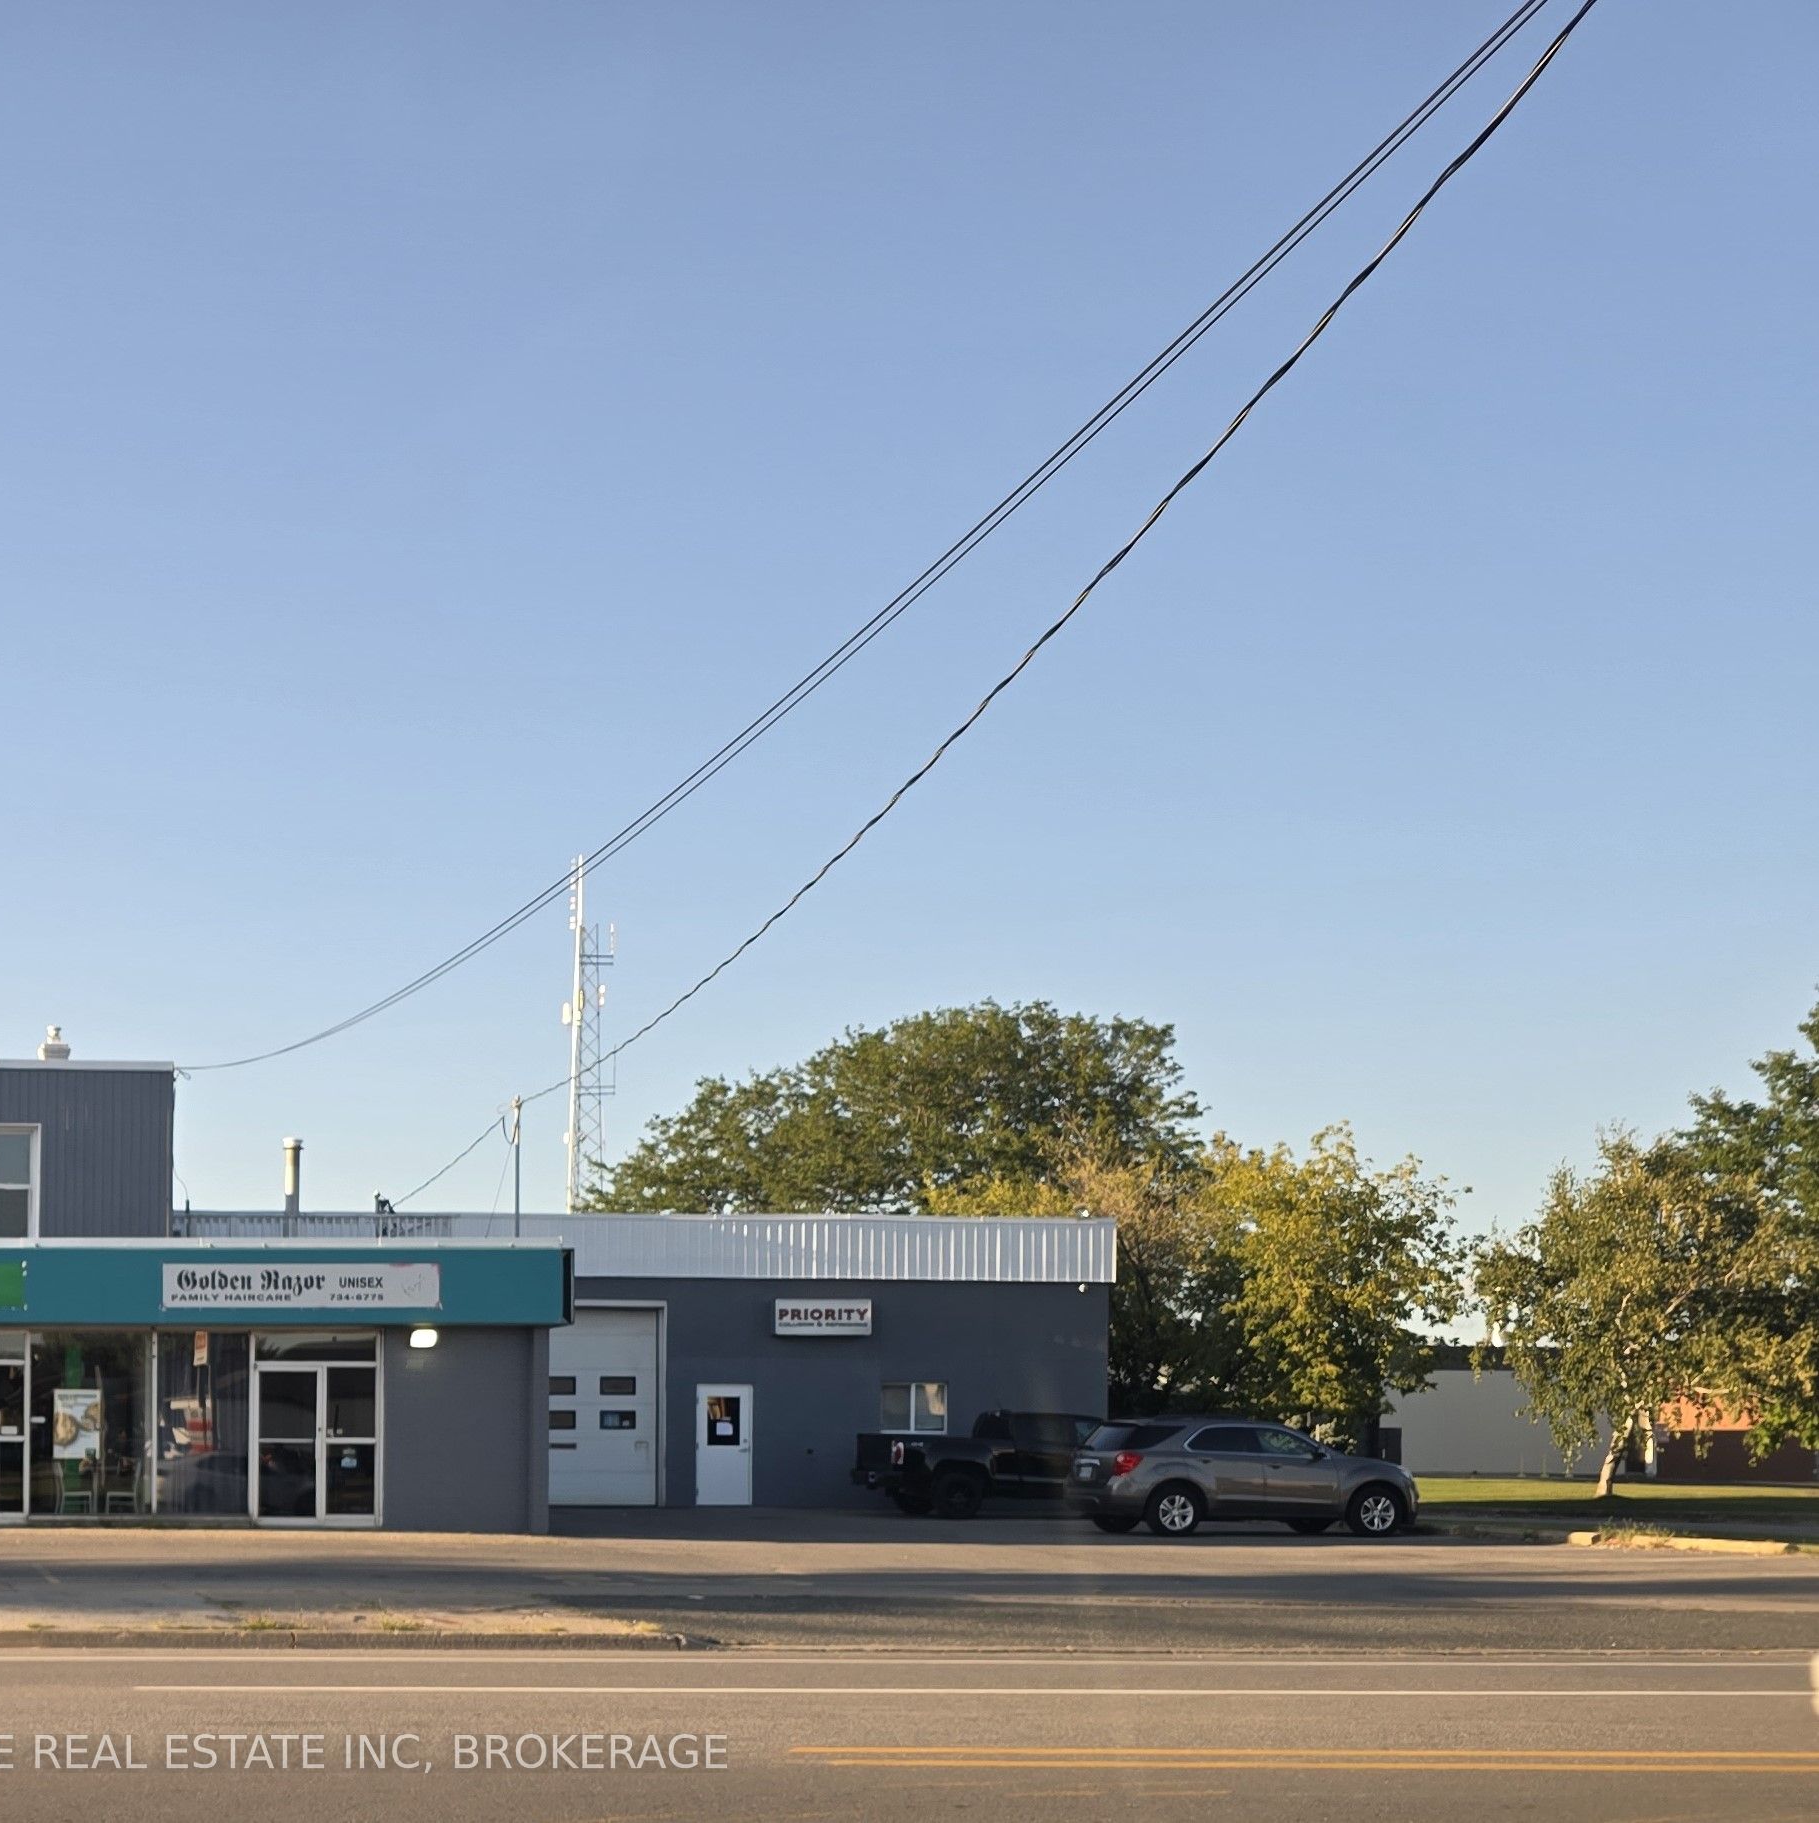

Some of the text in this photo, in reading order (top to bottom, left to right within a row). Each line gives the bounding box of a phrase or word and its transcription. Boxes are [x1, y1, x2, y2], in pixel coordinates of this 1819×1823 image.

[176, 1269, 384, 1297] Golden Razor UNISEX
[170, 1293, 220, 1302] FAMILY
[777, 1308, 869, 1321] PRIORITY
